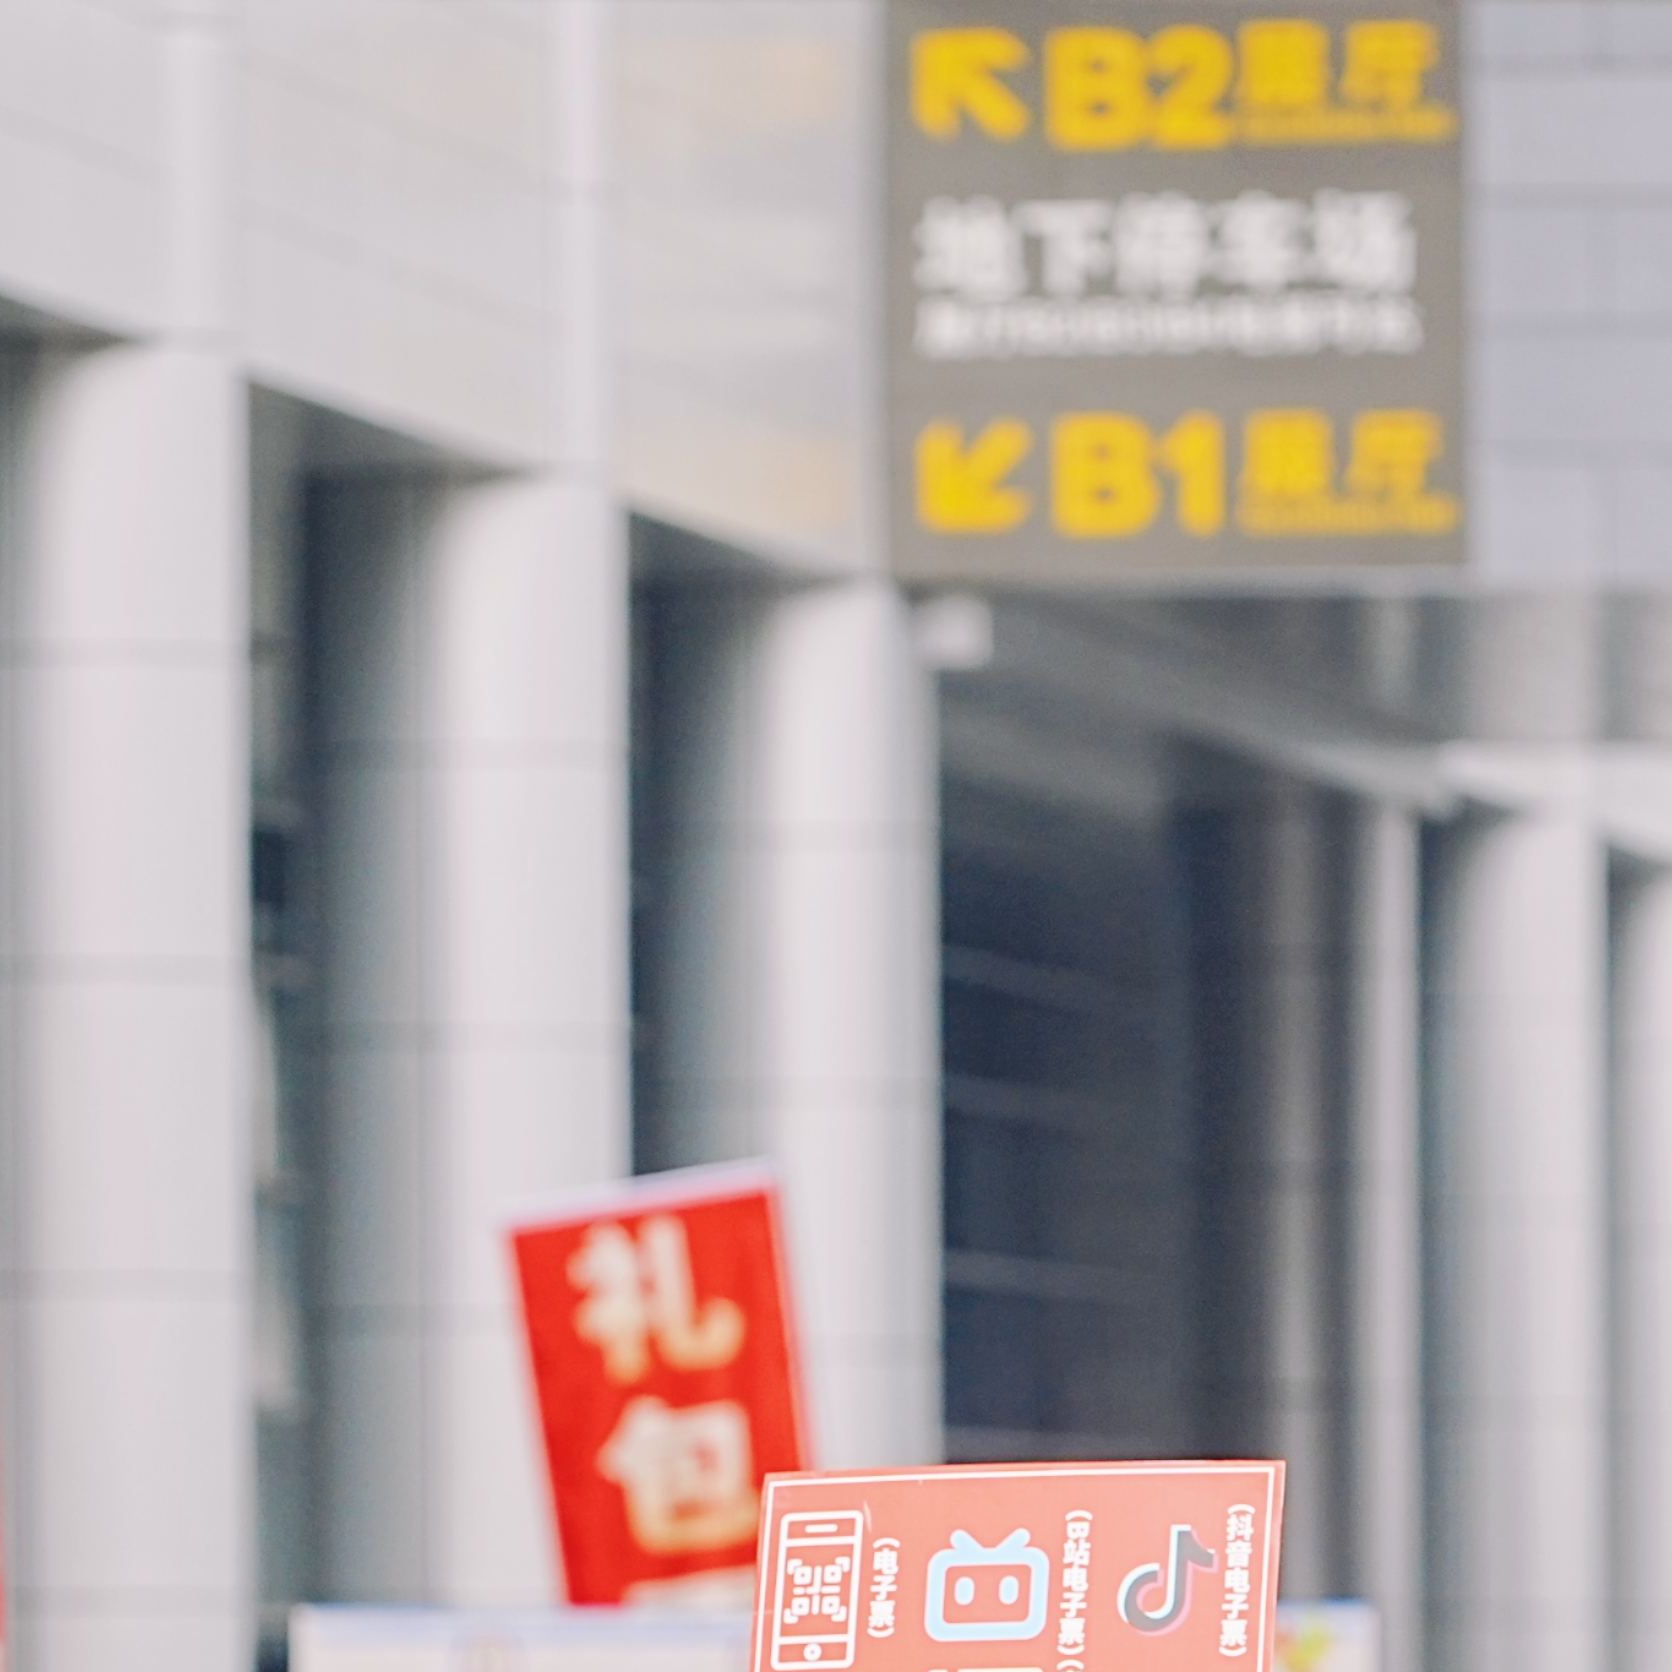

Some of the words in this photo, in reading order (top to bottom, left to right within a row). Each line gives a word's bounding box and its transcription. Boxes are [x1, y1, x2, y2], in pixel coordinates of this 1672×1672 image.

[914, 190, 1418, 302] 地下停车场
[566, 1212, 760, 1556] 礼包
[867, 1537, 900, 1638] （电子票）
[1218, 1503, 1255, 1657] （抖音电子票）
